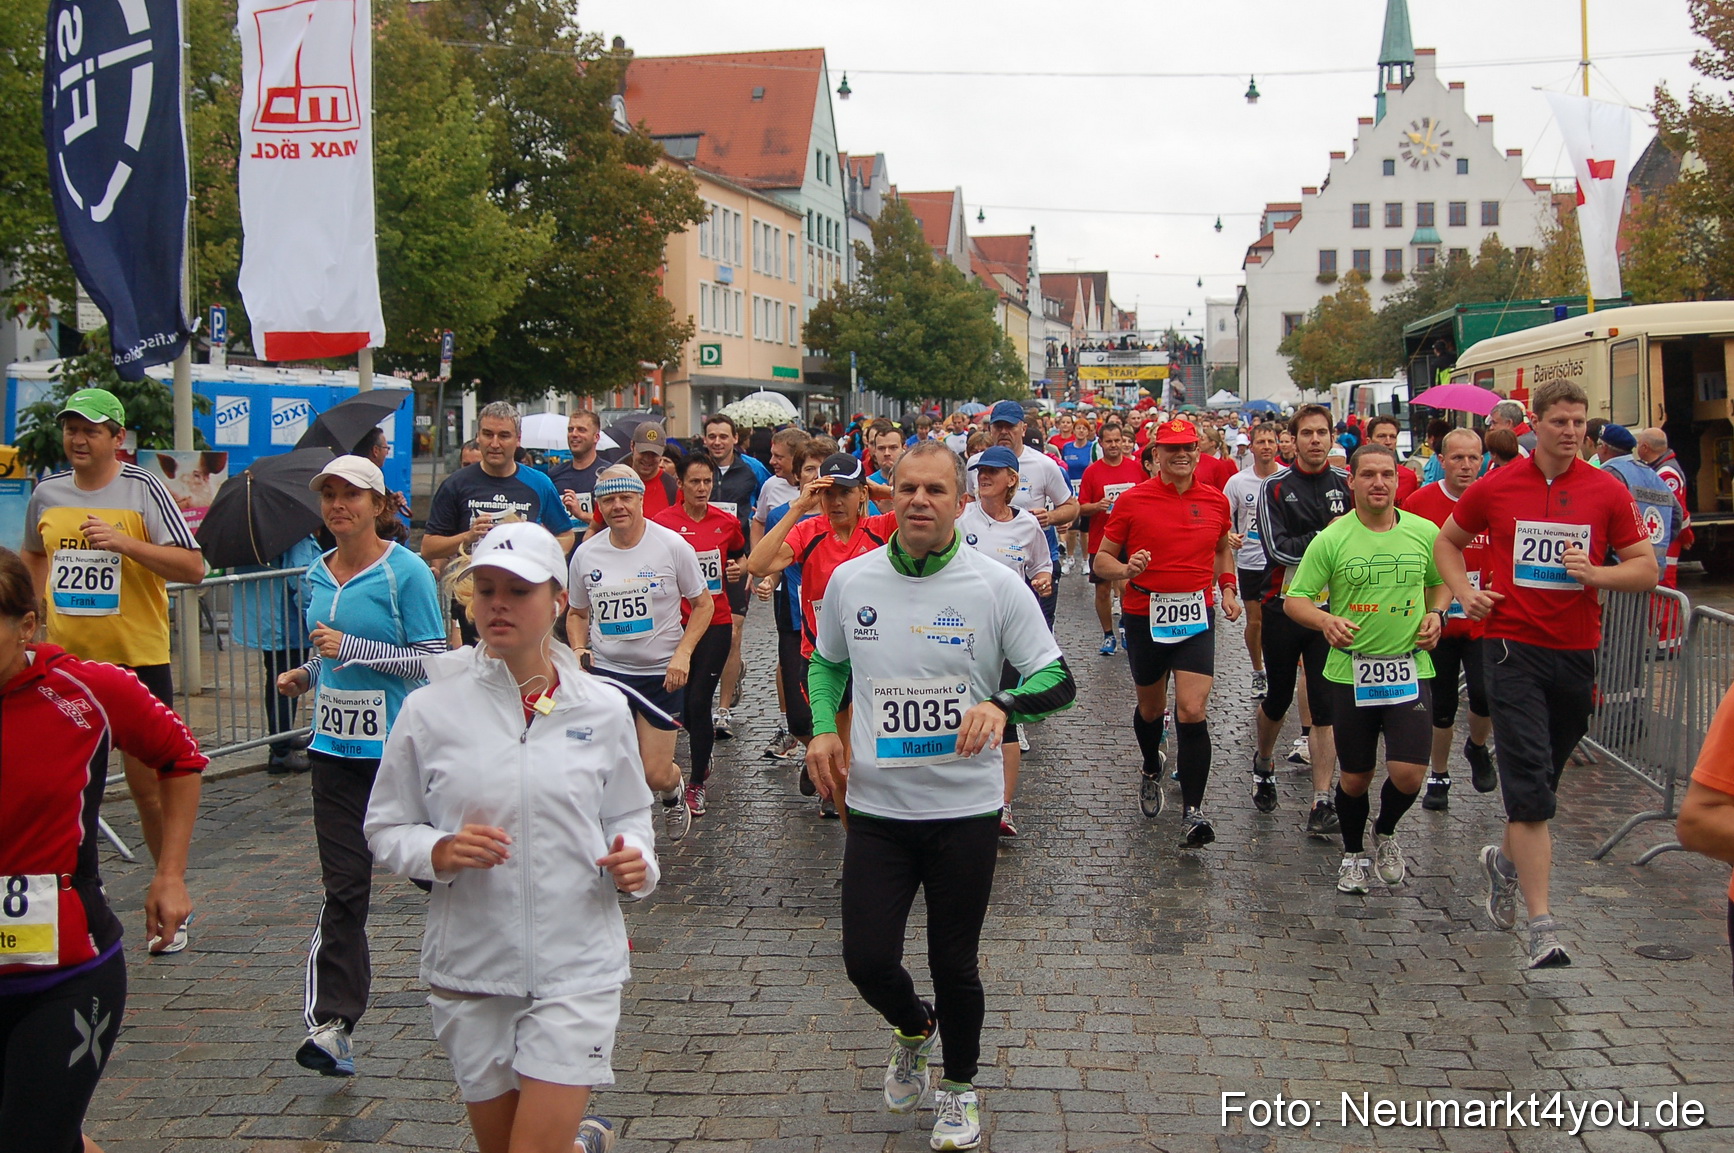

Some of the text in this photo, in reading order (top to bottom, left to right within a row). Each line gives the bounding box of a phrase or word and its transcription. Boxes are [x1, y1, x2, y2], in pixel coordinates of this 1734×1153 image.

[213, 311, 223, 339] P
[703, 346, 718, 363] D
[1107, 369, 1139, 377] START
[1534, 358, 1584, 383] Bayerisches
[493, 494, 508, 503] 40.
[468, 499, 532, 511] Hermannslauf
[1330, 500, 1344, 513] 44
[1518, 527, 1579, 538] PARTL Neumarkt
[76, 556, 109, 564] Neumarkt
[1344, 553, 1422, 586] OPF
[1533, 569, 1567, 580] Roland
[57, 565, 114, 590] 2266
[611, 588, 640, 597] Neumarkt
[70, 596, 96, 606] Frank
[598, 596, 648, 621] 2755
[1156, 603, 1202, 624] 2099
[1349, 604, 1379, 613] MERZ
[616, 624, 633, 633] Rudi
[910, 626, 925, 634] 14.
[1172, 627, 1187, 636] Karl
[1359, 661, 1411, 684] 2935
[874, 686, 952, 696] PARTL Neumarkt
[1368, 688, 1405, 698] Christian
[333, 697, 370, 706] Neumarkt
[321, 704, 378, 737] 2978
[882, 698, 962, 733] 3035
[331, 741, 362, 755] Sabine
[902, 740, 943, 755] Martin
[3, 875, 29, 918] 8
[0, 931, 17, 949] te
